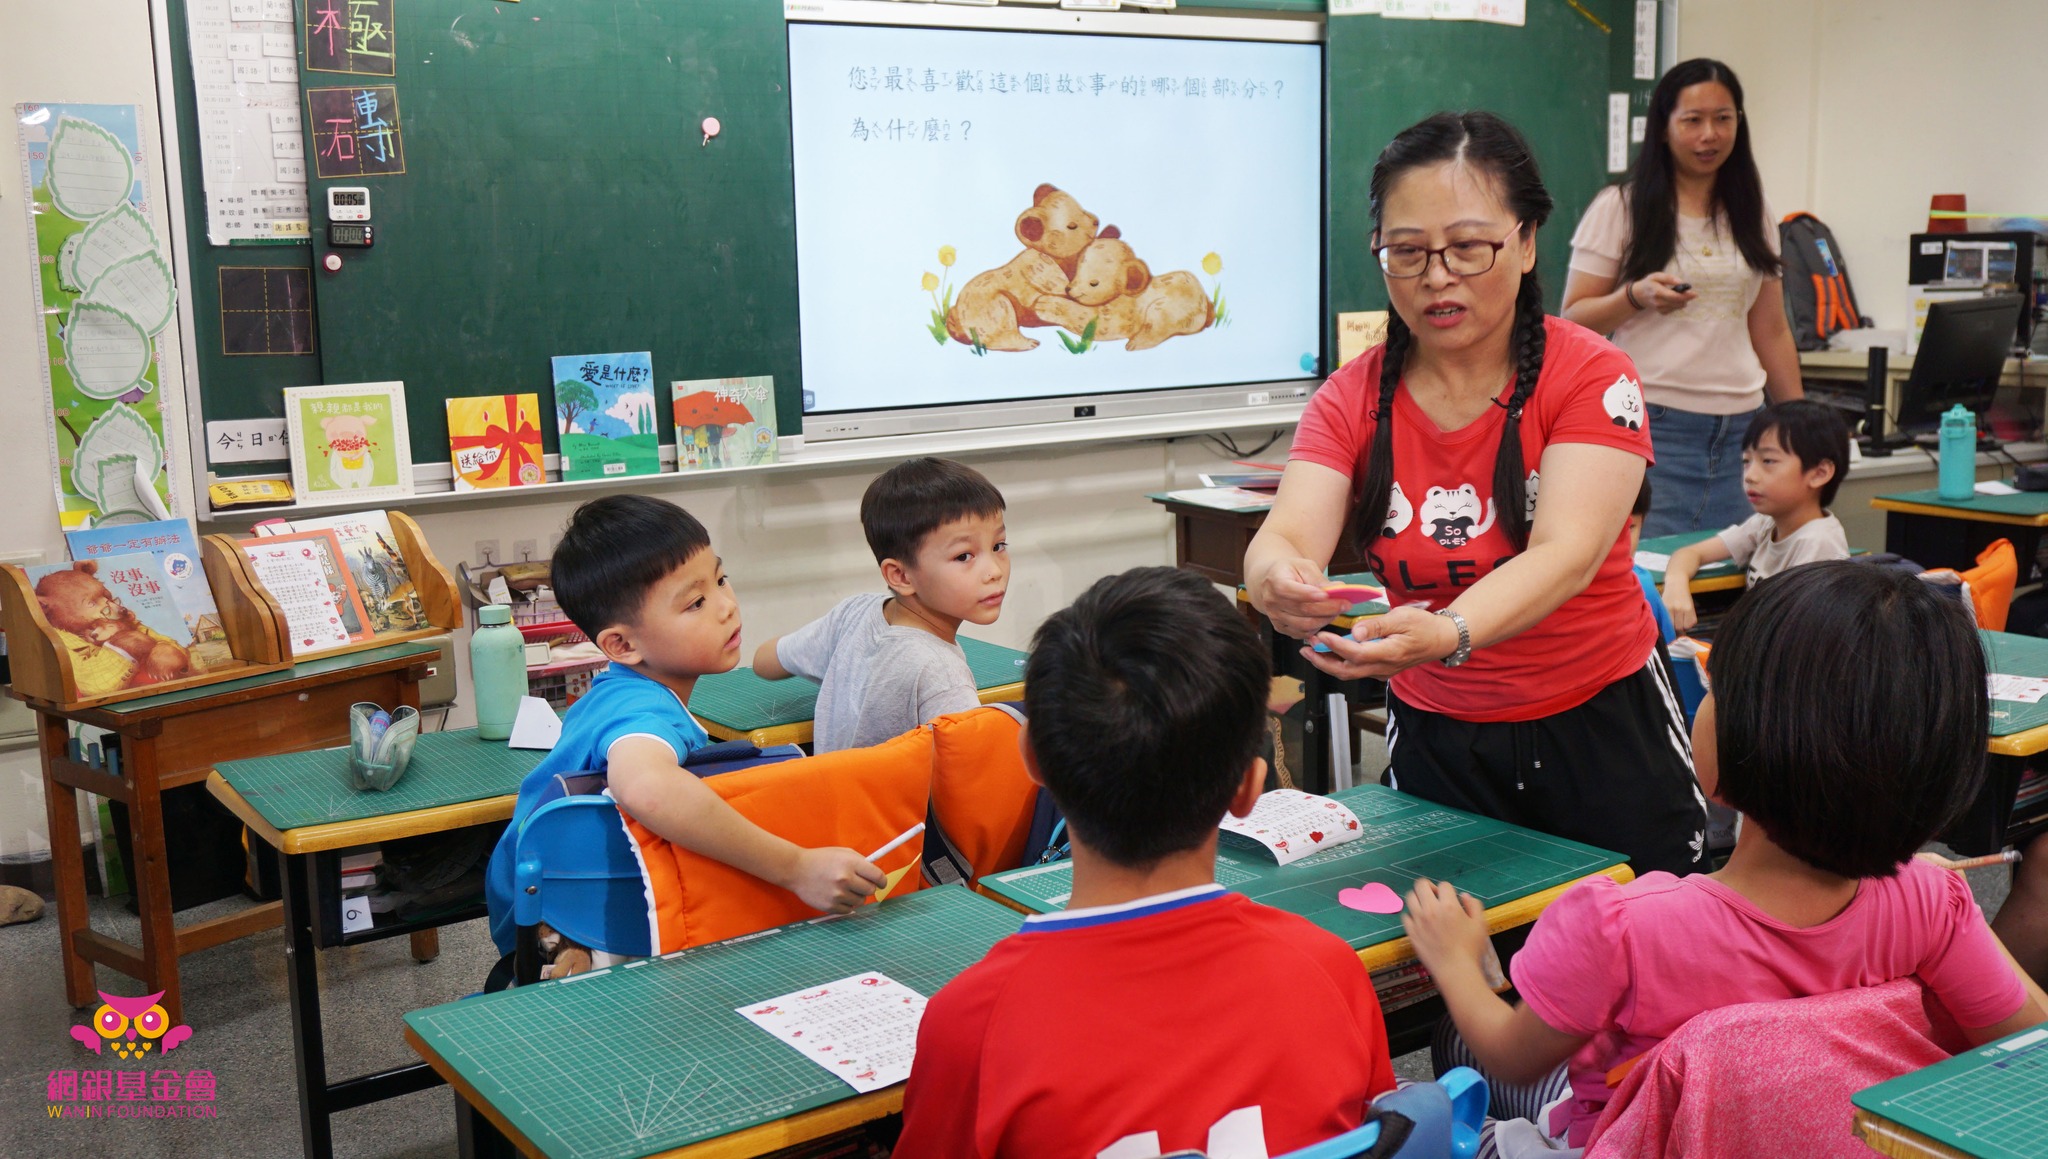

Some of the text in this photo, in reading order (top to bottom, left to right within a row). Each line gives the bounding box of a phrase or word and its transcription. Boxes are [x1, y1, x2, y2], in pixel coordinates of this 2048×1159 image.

[580, 361, 649, 386] 愛是什麼?
[714, 384, 769, 406] 神奇大傘
[310, 401, 383, 414] 親親都是我的
[461, 450, 498, 468] 送給你
[86, 534, 181, 555] 爺爺一定有辦法
[127, 580, 161, 597] 沒事
